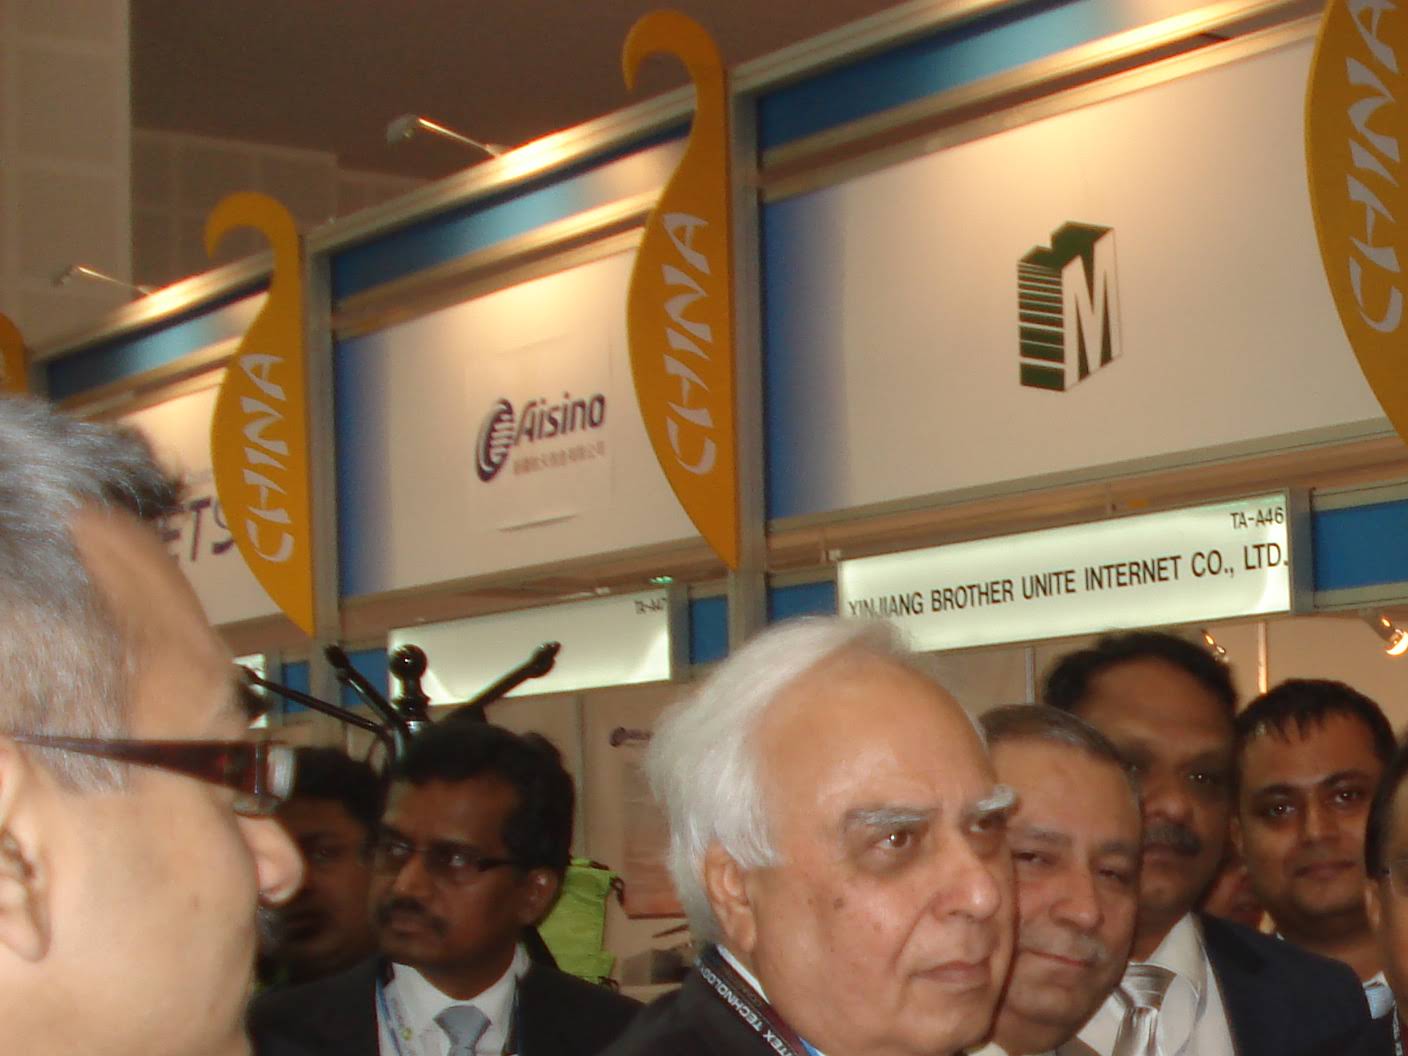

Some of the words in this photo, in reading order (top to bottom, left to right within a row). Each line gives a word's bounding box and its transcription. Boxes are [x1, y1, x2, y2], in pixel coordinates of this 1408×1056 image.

[1346, 0, 1403, 333] CHINA
[661, 211, 716, 476] CHINA
[239, 353, 295, 563] CHINA
[1230, 507, 1285, 530] TA-A46
[930, 578, 1014, 614] BROTHER
[1021, 570, 1076, 600] UNITE
[1085, 555, 1182, 591] INTERNET
[1191, 550, 1235, 579] CO.,
[1243, 542, 1288, 571] LTD.
